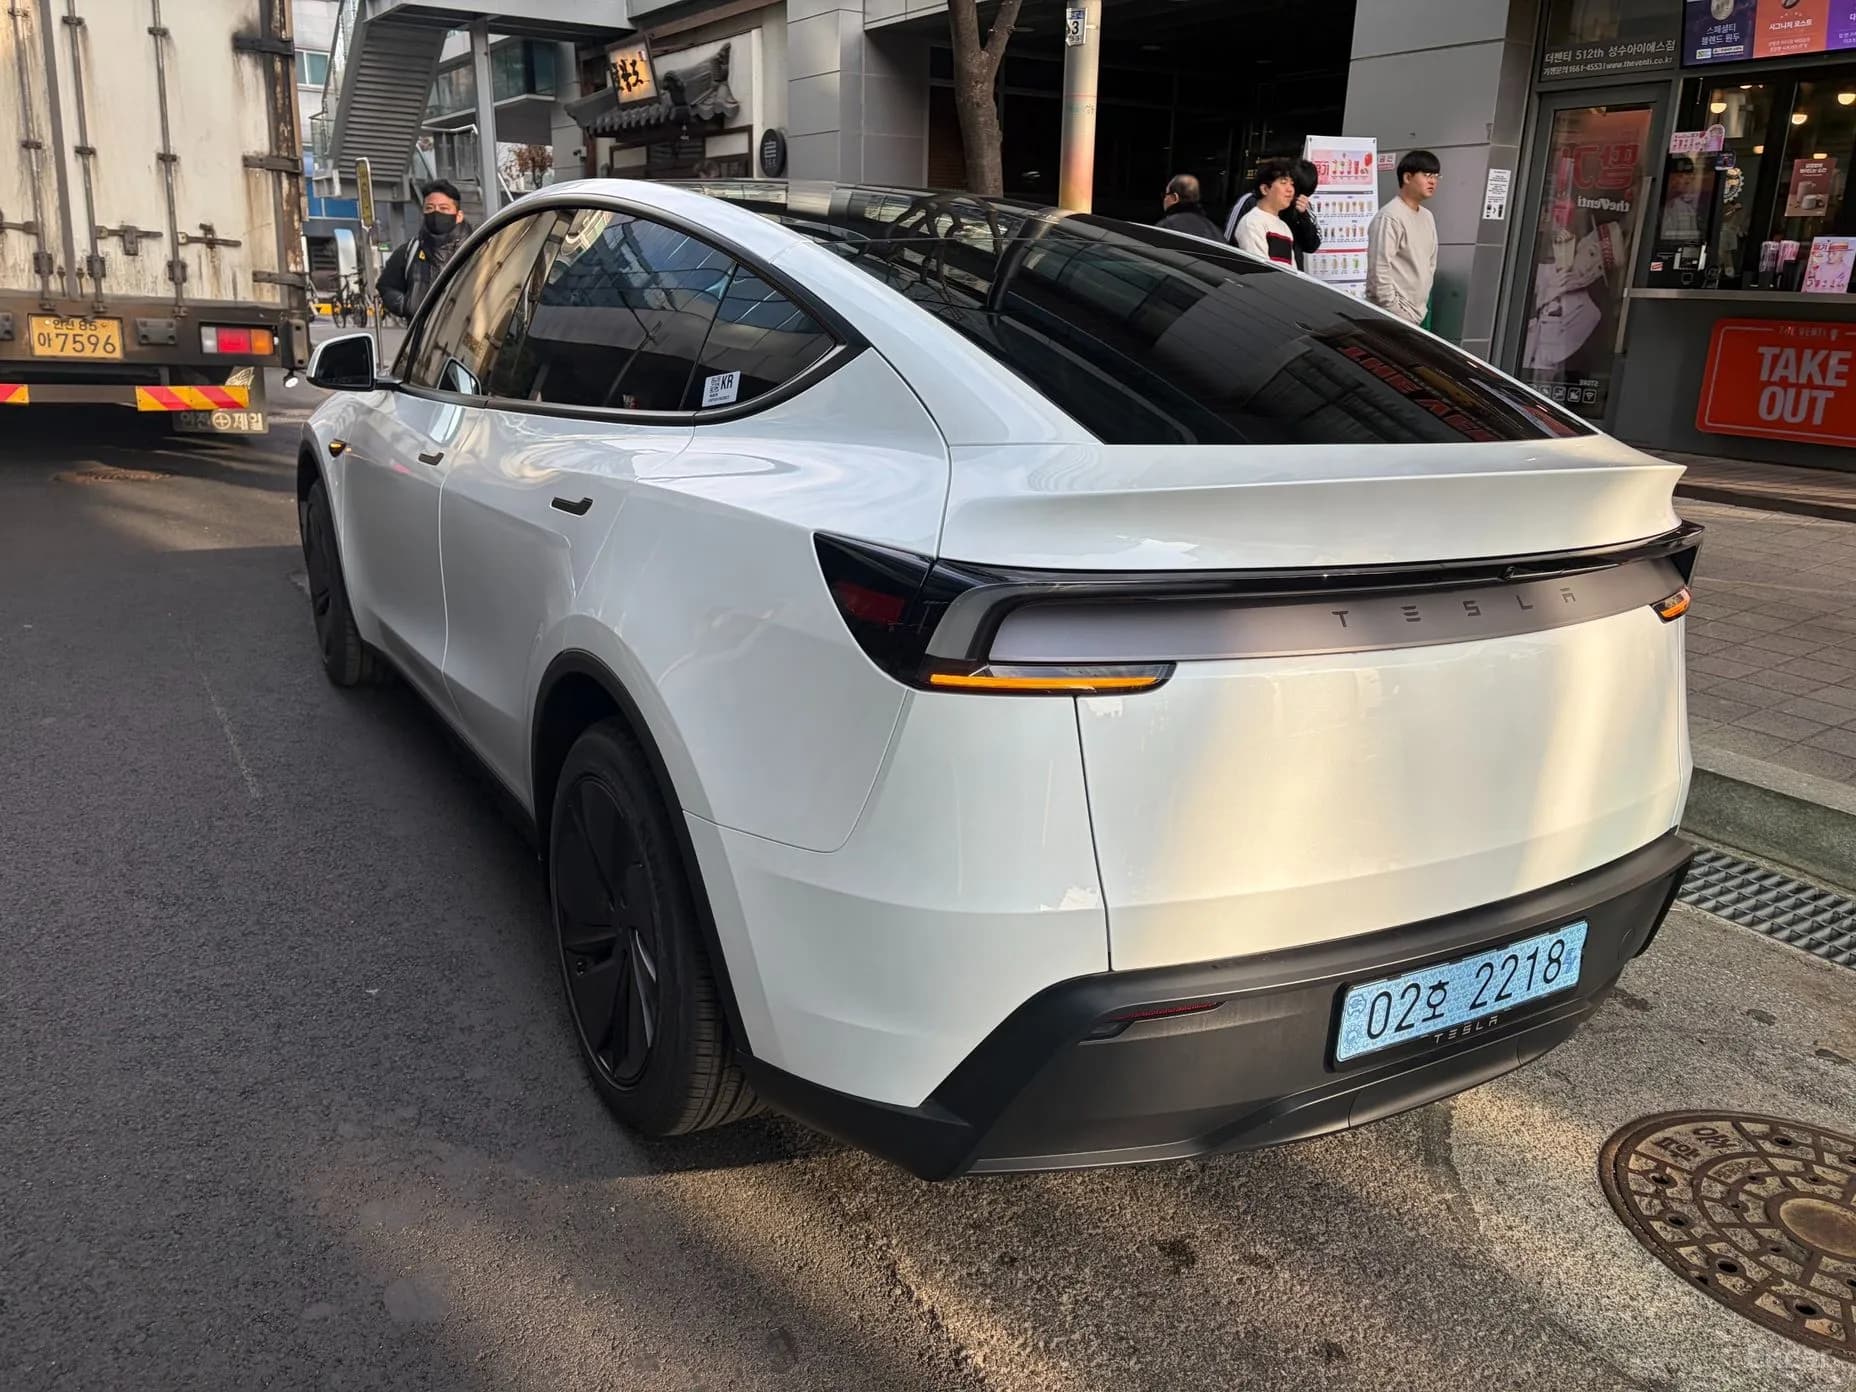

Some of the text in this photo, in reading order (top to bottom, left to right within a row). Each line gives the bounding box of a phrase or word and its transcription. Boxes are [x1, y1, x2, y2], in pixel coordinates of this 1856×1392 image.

[1702, 33, 1740, 46] 블렌드 원두
[1706, 23, 1736, 35] 스페셜티
[1545, 50, 1572, 64] 더벤티
[1576, 48, 1604, 60] 512th
[1758, 346, 1852, 387] TAKE
[721, 374, 734, 390] KR
[1758, 386, 1835, 425] OUT
[232, 412, 263, 431] 제일
[1331, 587, 1577, 628] TESLA
[1366, 938, 1566, 1040] 02호 2218
[1433, 1015, 1499, 1044] TESLA
